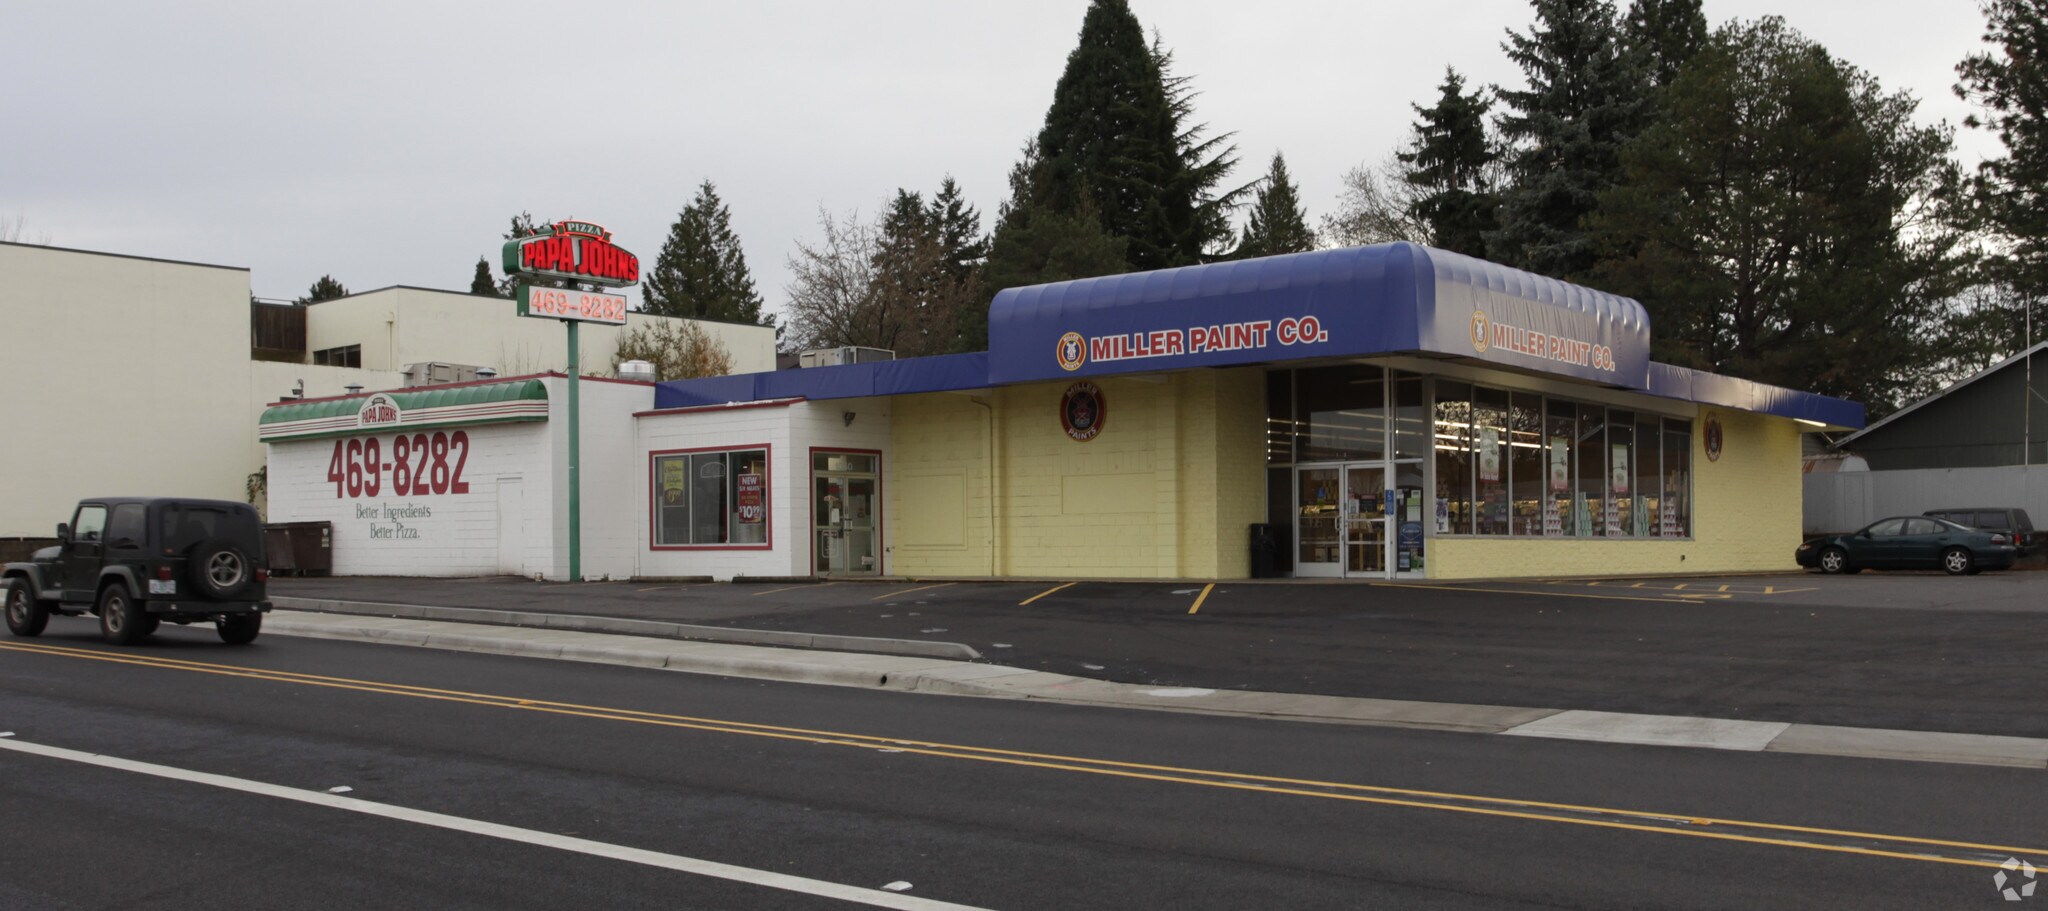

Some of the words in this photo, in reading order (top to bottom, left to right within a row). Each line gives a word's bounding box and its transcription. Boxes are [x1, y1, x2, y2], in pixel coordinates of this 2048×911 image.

[568, 222, 602, 236] PIZZA
[523, 237, 575, 272] PAPA
[532, 290, 624, 320] 469-8282
[1090, 329, 1184, 363] MILLER
[1189, 320, 1271, 353] PAINT
[1277, 315, 1328, 345] CO.
[1492, 322, 1547, 359] MILLER
[1549, 336, 1589, 366] PAINT
[1592, 345, 1615, 372] CO.
[1066, 383, 1098, 398] MILLER
[362, 407, 377, 423] PAPA
[1068, 428, 1097, 440] PAINTS
[327, 430, 469, 499] 469-8282
[741, 476, 757, 485] NEW
[356, 503, 379, 519] Better
[383, 502, 431, 523] Ingredients
[370, 522, 393, 539] Better
[396, 522, 420, 539] Pizza.
